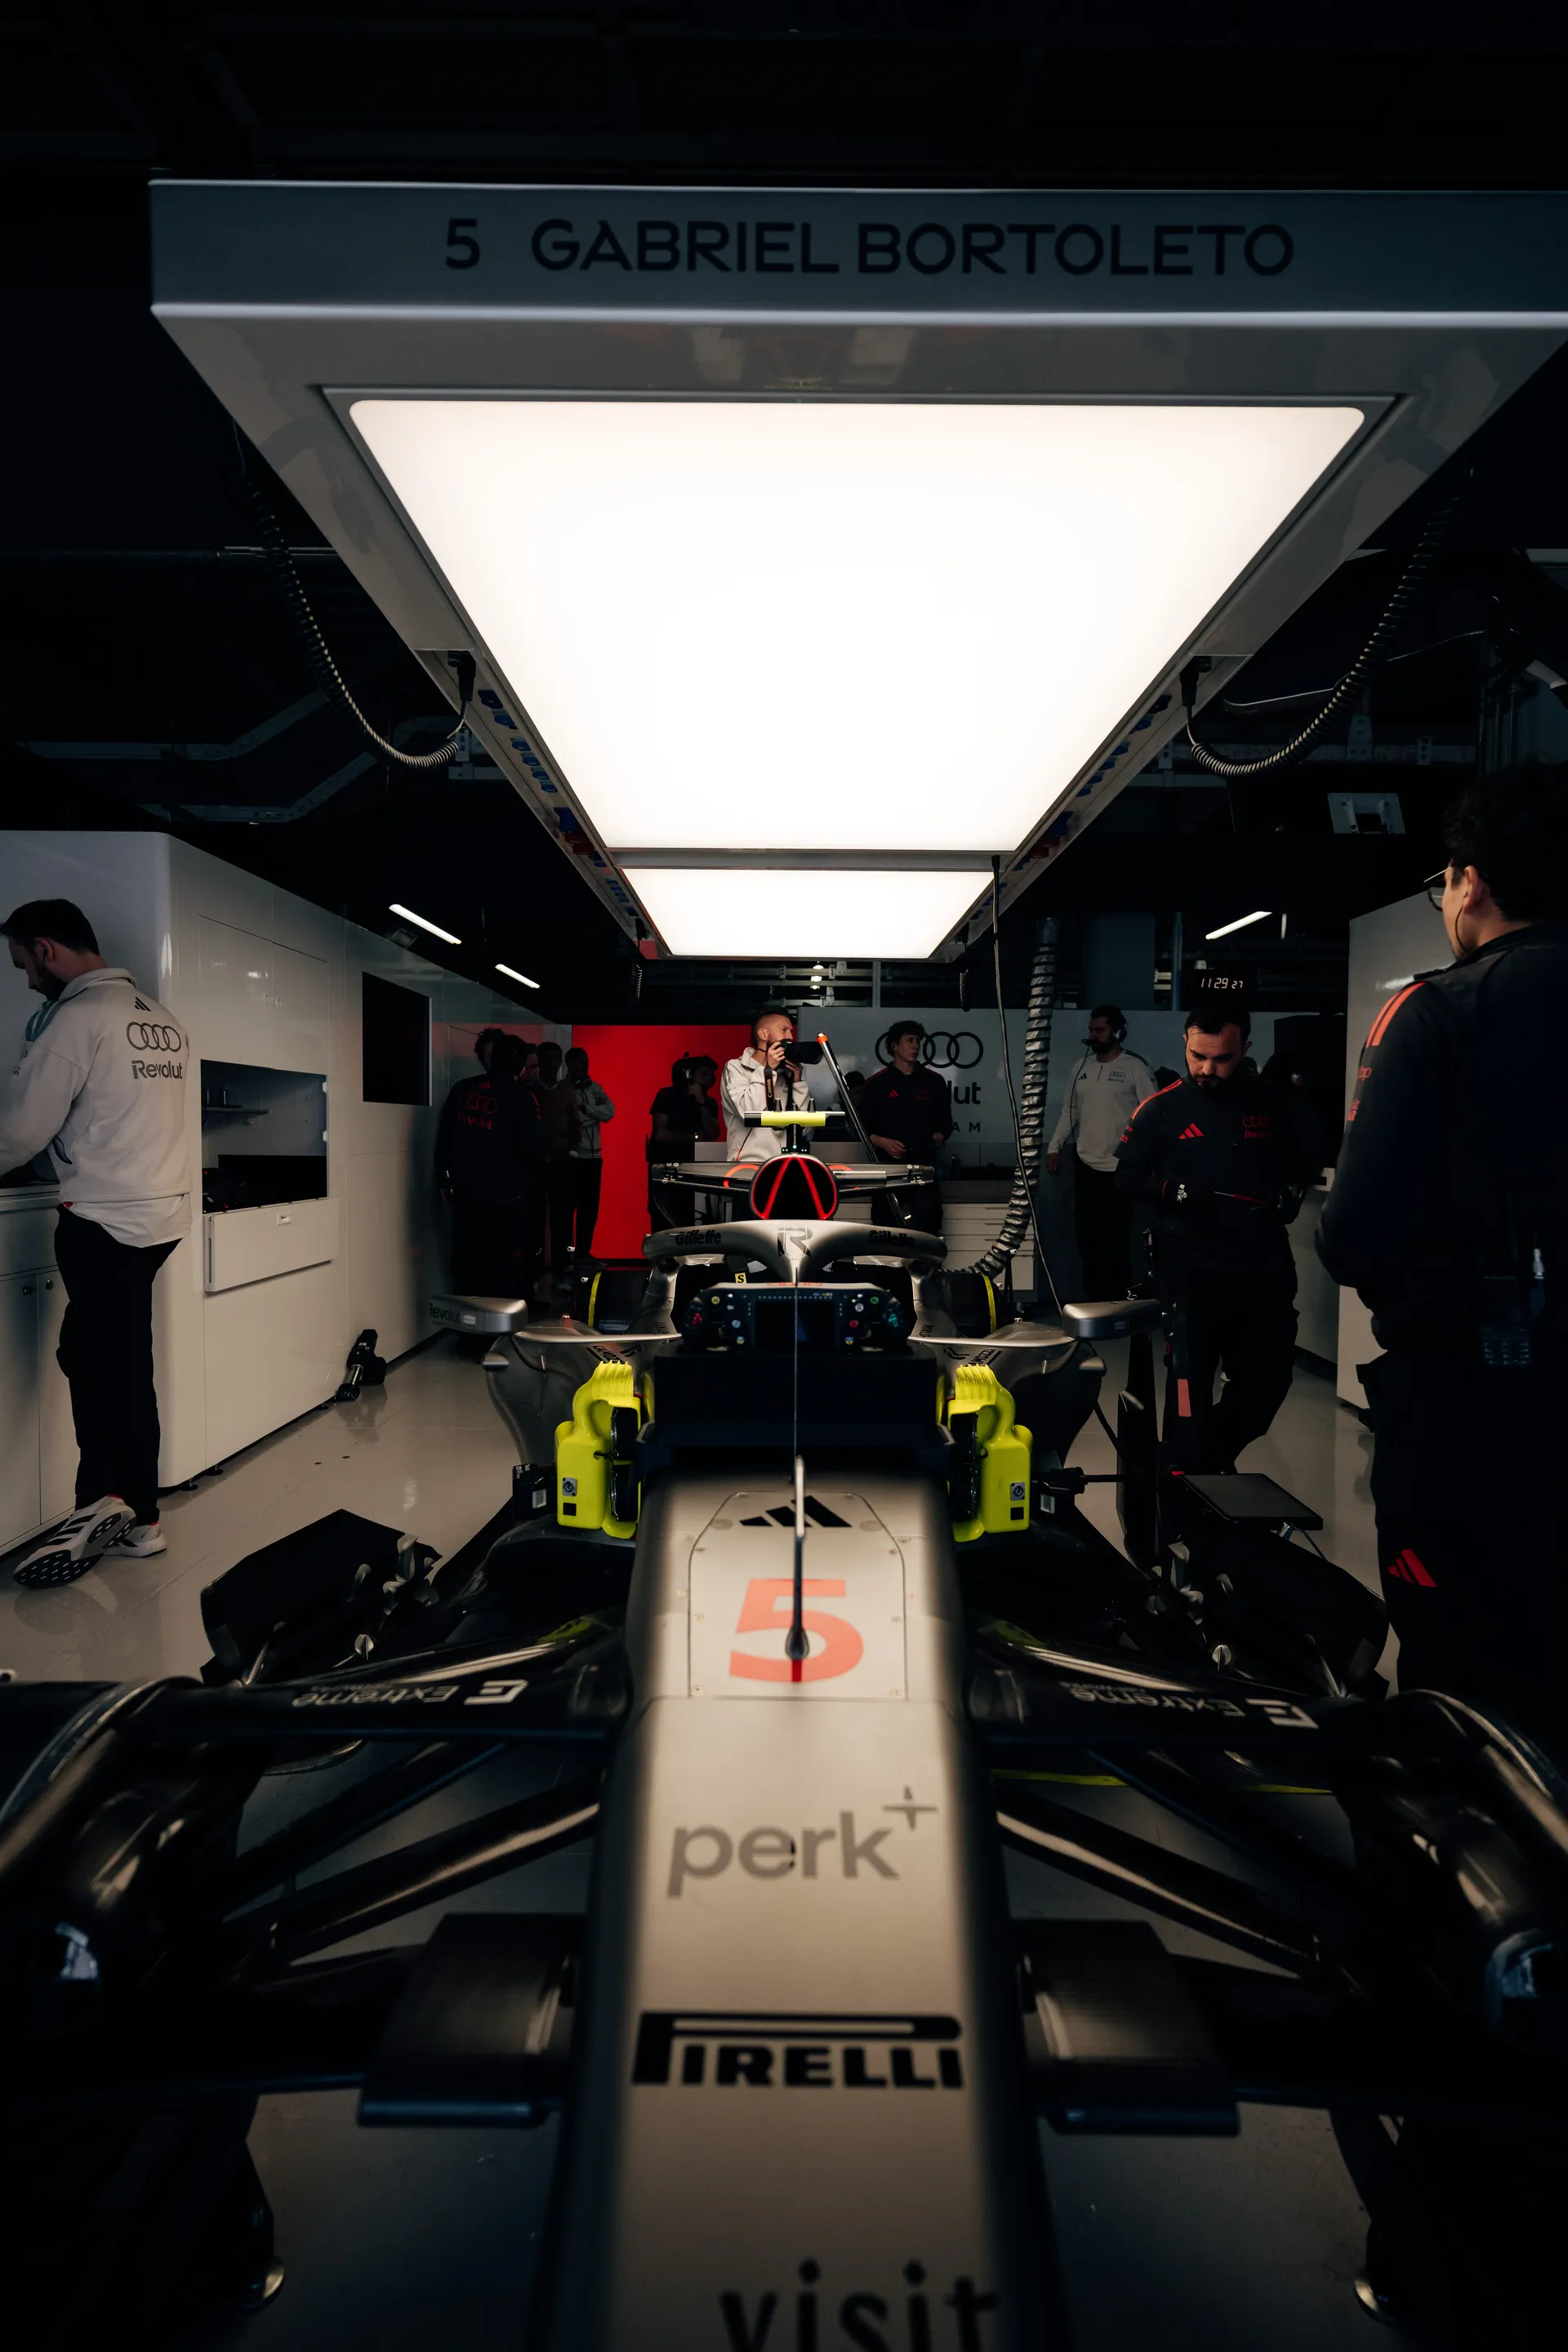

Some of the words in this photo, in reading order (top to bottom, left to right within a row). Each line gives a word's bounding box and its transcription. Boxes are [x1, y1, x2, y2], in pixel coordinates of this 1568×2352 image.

[445, 218, 480, 269] 5
[531, 219, 840, 273] GABRIEL
[858, 223, 1294, 276] BORTOLETO
[131, 1060, 182, 1079] Revolut
[728, 1578, 864, 1682] 5
[291, 1684, 461, 1708] Extreme
[1069, 1686, 1246, 1717] Extreme
[631, 2012, 964, 2088] PIRELLI
[719, 2258, 1003, 2352] visit
